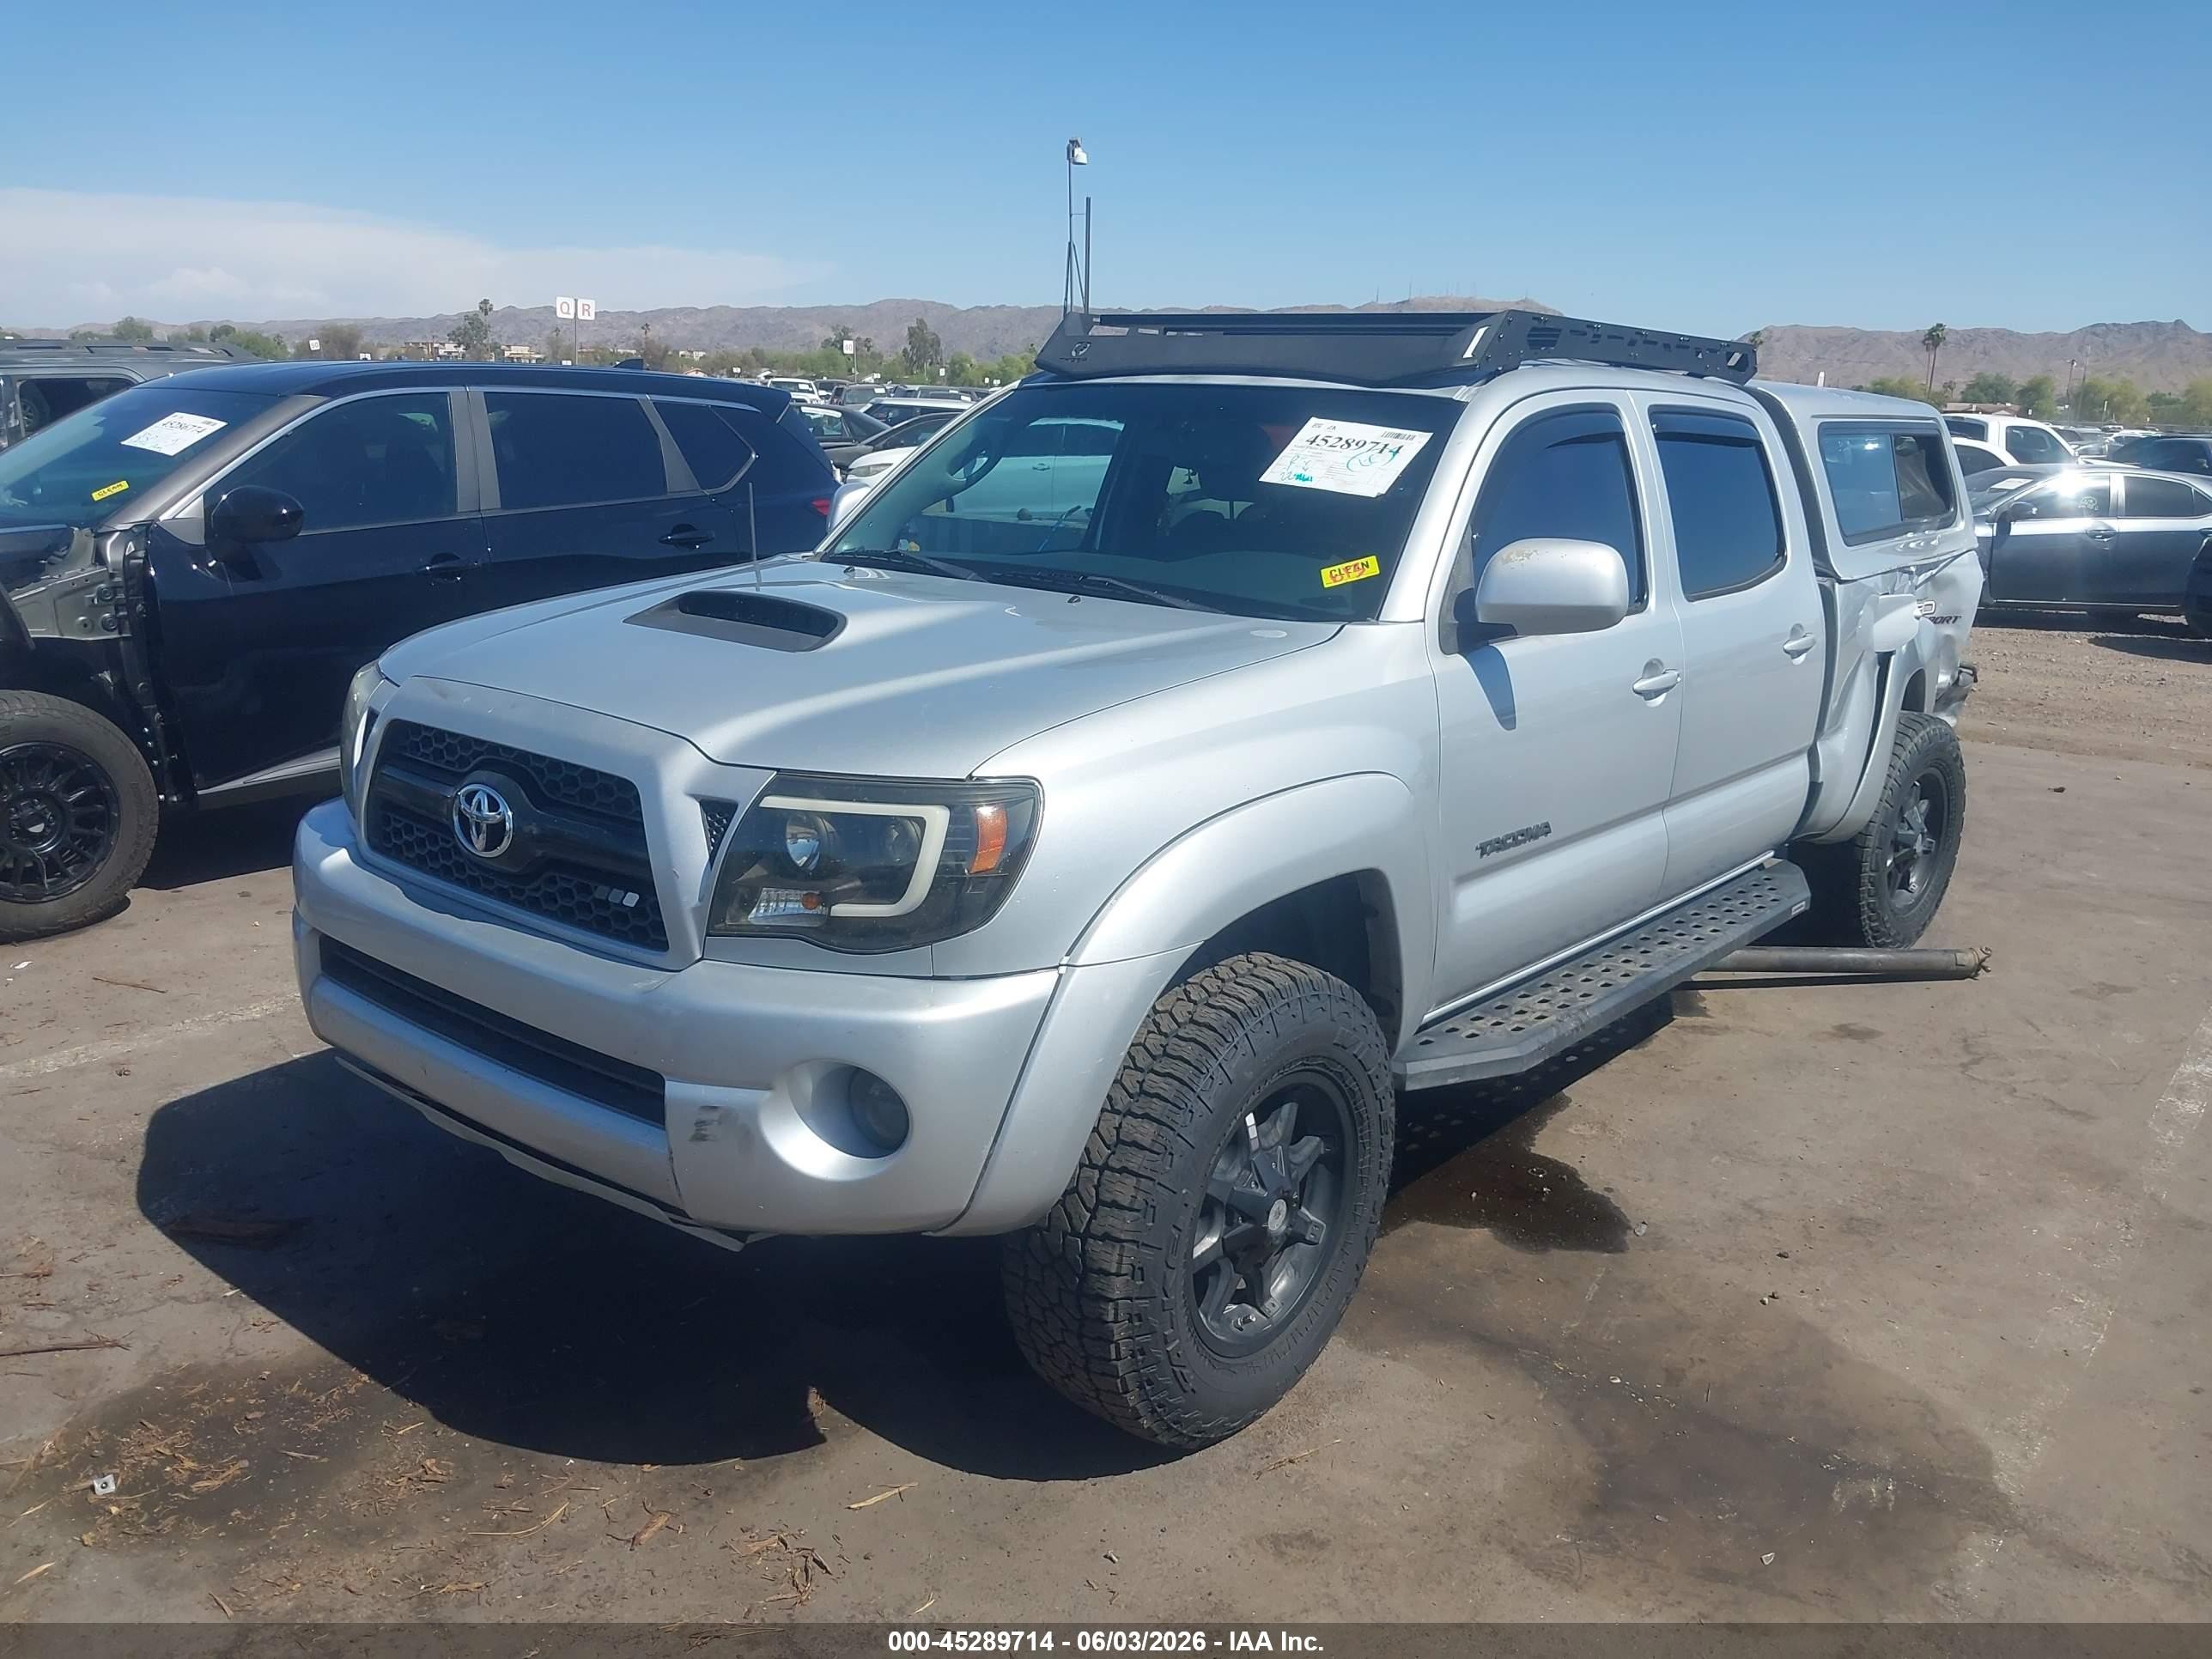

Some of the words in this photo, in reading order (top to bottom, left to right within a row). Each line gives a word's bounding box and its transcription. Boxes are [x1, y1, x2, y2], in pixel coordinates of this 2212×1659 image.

[559, 301, 571, 315] Q
[581, 303, 591, 317] R
[1305, 434, 1405, 455] 45289714
[1475, 821, 1552, 860] TACOMA
